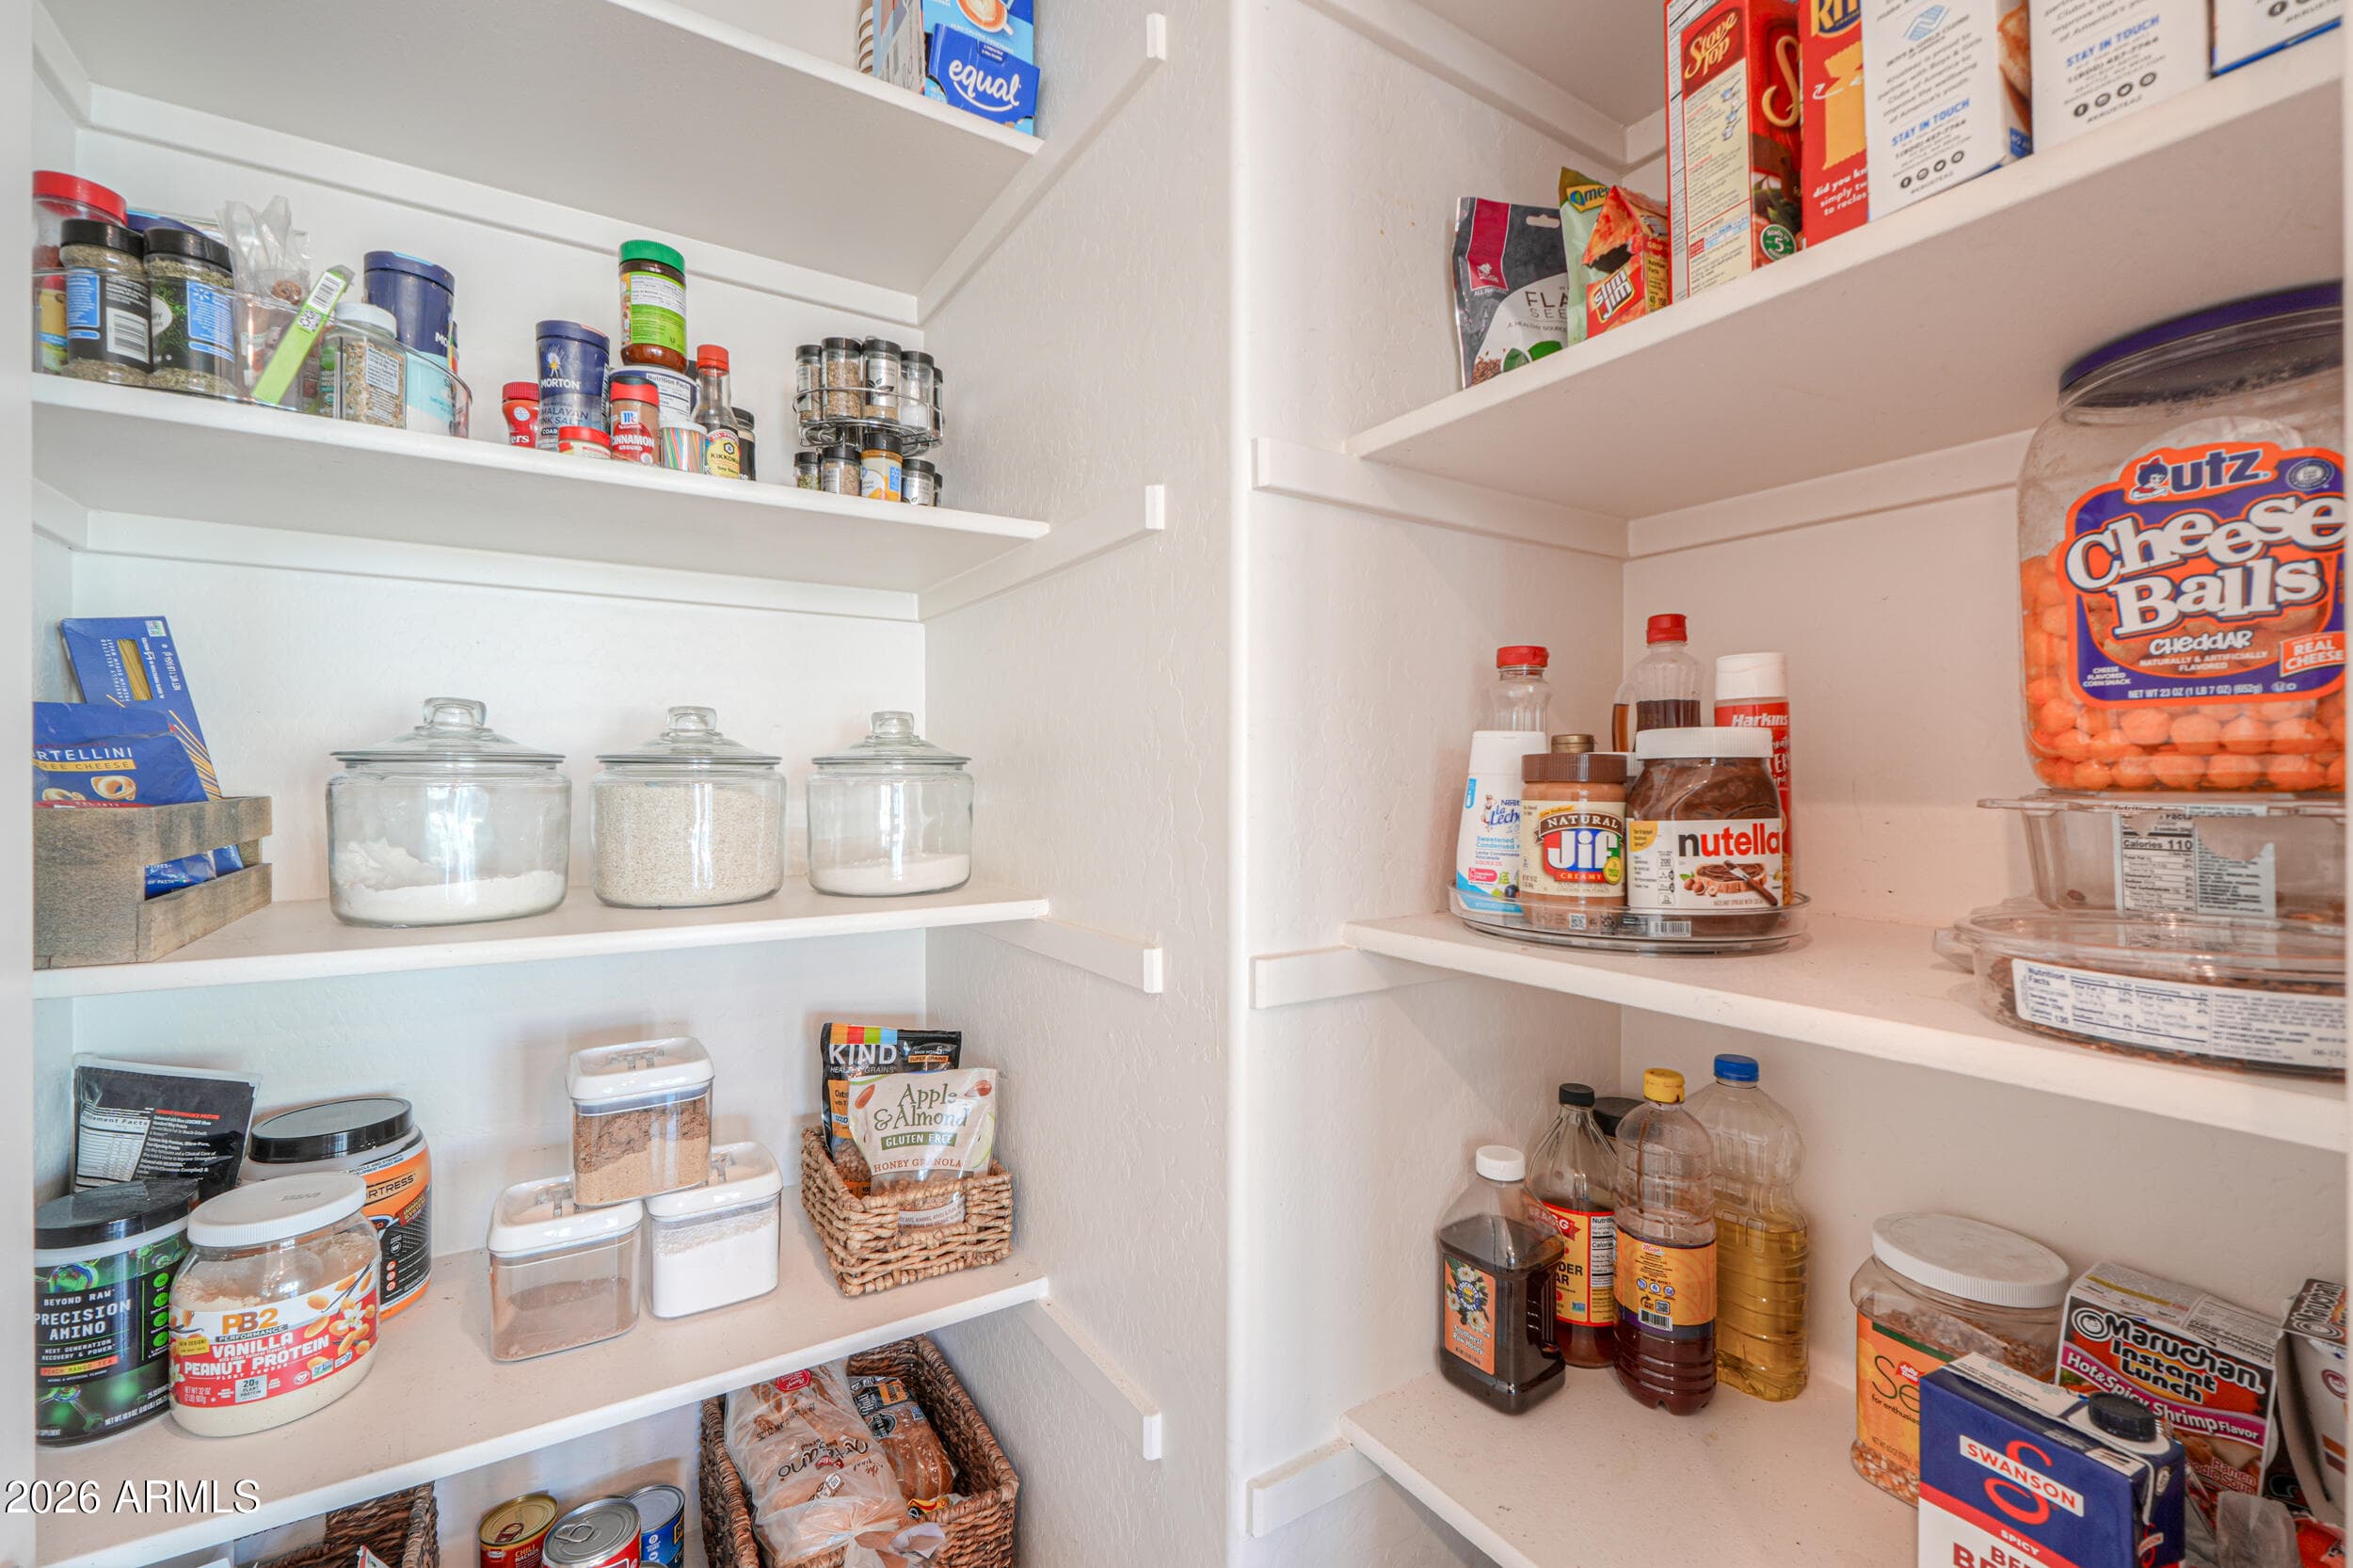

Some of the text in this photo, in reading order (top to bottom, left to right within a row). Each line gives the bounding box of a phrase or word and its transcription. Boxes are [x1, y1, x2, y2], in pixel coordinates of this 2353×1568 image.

[1684, 11, 1738, 79] Stove
[2066, 14, 2159, 67] STAY IN TOUCH
[949, 59, 1021, 106] equal
[1891, 97, 1971, 146] STAY IN TOUCH
[1813, 175, 1852, 198] did you
[1819, 184, 1852, 208] simply
[1823, 204, 1836, 216] to
[1774, 236, 1785, 252] 5
[540, 378, 580, 390] MORTON
[648, 374, 675, 385] Nutrition
[612, 434, 655, 447] CINNAMON
[2066, 496, 2345, 590] Cheese
[2108, 557, 2323, 636] Balls
[2294, 639, 2335, 654] REAL
[2138, 657, 2192, 667] NATURALLY
[2203, 650, 2267, 663] ARTIFICIALLY
[2285, 650, 2345, 670] CHEESE
[2087, 672, 2126, 680] FLAVORED
[2178, 663, 2228, 672] FLAVORED
[2083, 679, 2131, 688] CORN SNACK
[2128, 689, 2144, 698] NET
[2145, 689, 2159, 698] WT
[2161, 688, 2173, 697] 23
[2174, 688, 2185, 696] OZ
[2195, 687, 2207, 696] LB
[2216, 685, 2233, 696] OZ)
[1731, 712, 1788, 728] Harkins
[74, 760, 130, 770] CHEESE
[1546, 815, 1619, 829] NATURAL
[1476, 835, 1514, 843] Sweetened
[1678, 823, 1781, 856] nutella
[2123, 840, 2194, 851] Calories 110
[1547, 830, 1619, 869] Jif
[2028, 968, 2066, 981] Nutrition
[2028, 977, 2050, 986] Facts
[828, 1044, 897, 1065] KIND
[899, 1083, 958, 1110] Apple
[886, 1132, 952, 1148] GLUTEN FREE
[873, 1159, 910, 1172] HONEY
[368, 1175, 414, 1198] RTRESS
[1559, 1261, 1583, 1276] DER
[43, 1289, 111, 1306] BEYOND RAW
[34, 1299, 132, 1326] PRECISION
[222, 1307, 279, 1336] PB2
[49, 1321, 106, 1341] AMINO
[218, 1324, 284, 1342] PERFORMANCE
[64, 1339, 112, 1352] GENERATION
[88, 1346, 113, 1355] POWER
[211, 1332, 295, 1358] VANILLA
[1465, 1341, 1483, 1355] Honey
[2105, 1314, 2261, 1393] Maruchan
[184, 1335, 329, 1376] PEANUT PROTEIN
[2111, 1339, 2217, 1393] Instant
[2121, 1360, 2203, 1405] Lunch
[1871, 1393, 1882, 1404] for
[2153, 1402, 2218, 1433] Shrimp
[2219, 1421, 2260, 1440] Flavor
[1968, 1442, 2076, 1509] SWANSON
[2213, 1458, 2258, 1486] Ramen
[515, 1544, 536, 1557] CHILI
[2000, 1529, 2041, 1556] SPICY
